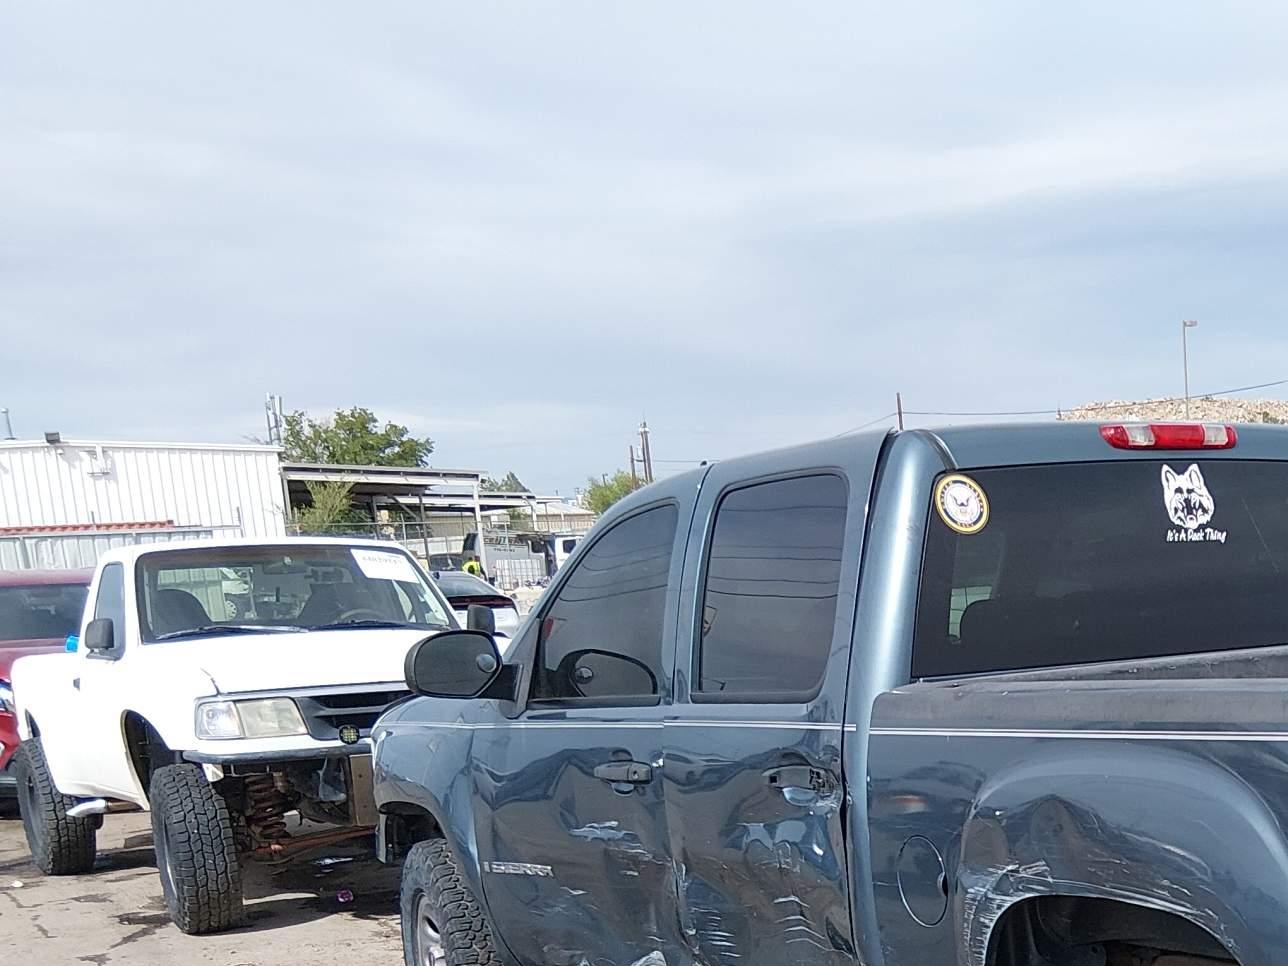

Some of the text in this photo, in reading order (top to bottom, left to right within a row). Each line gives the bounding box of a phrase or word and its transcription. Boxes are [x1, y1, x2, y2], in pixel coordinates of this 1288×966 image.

[1179, 528, 1187, 541] A
[1205, 527, 1227, 543] Thing
[491, 861, 554, 877] SIERRA
